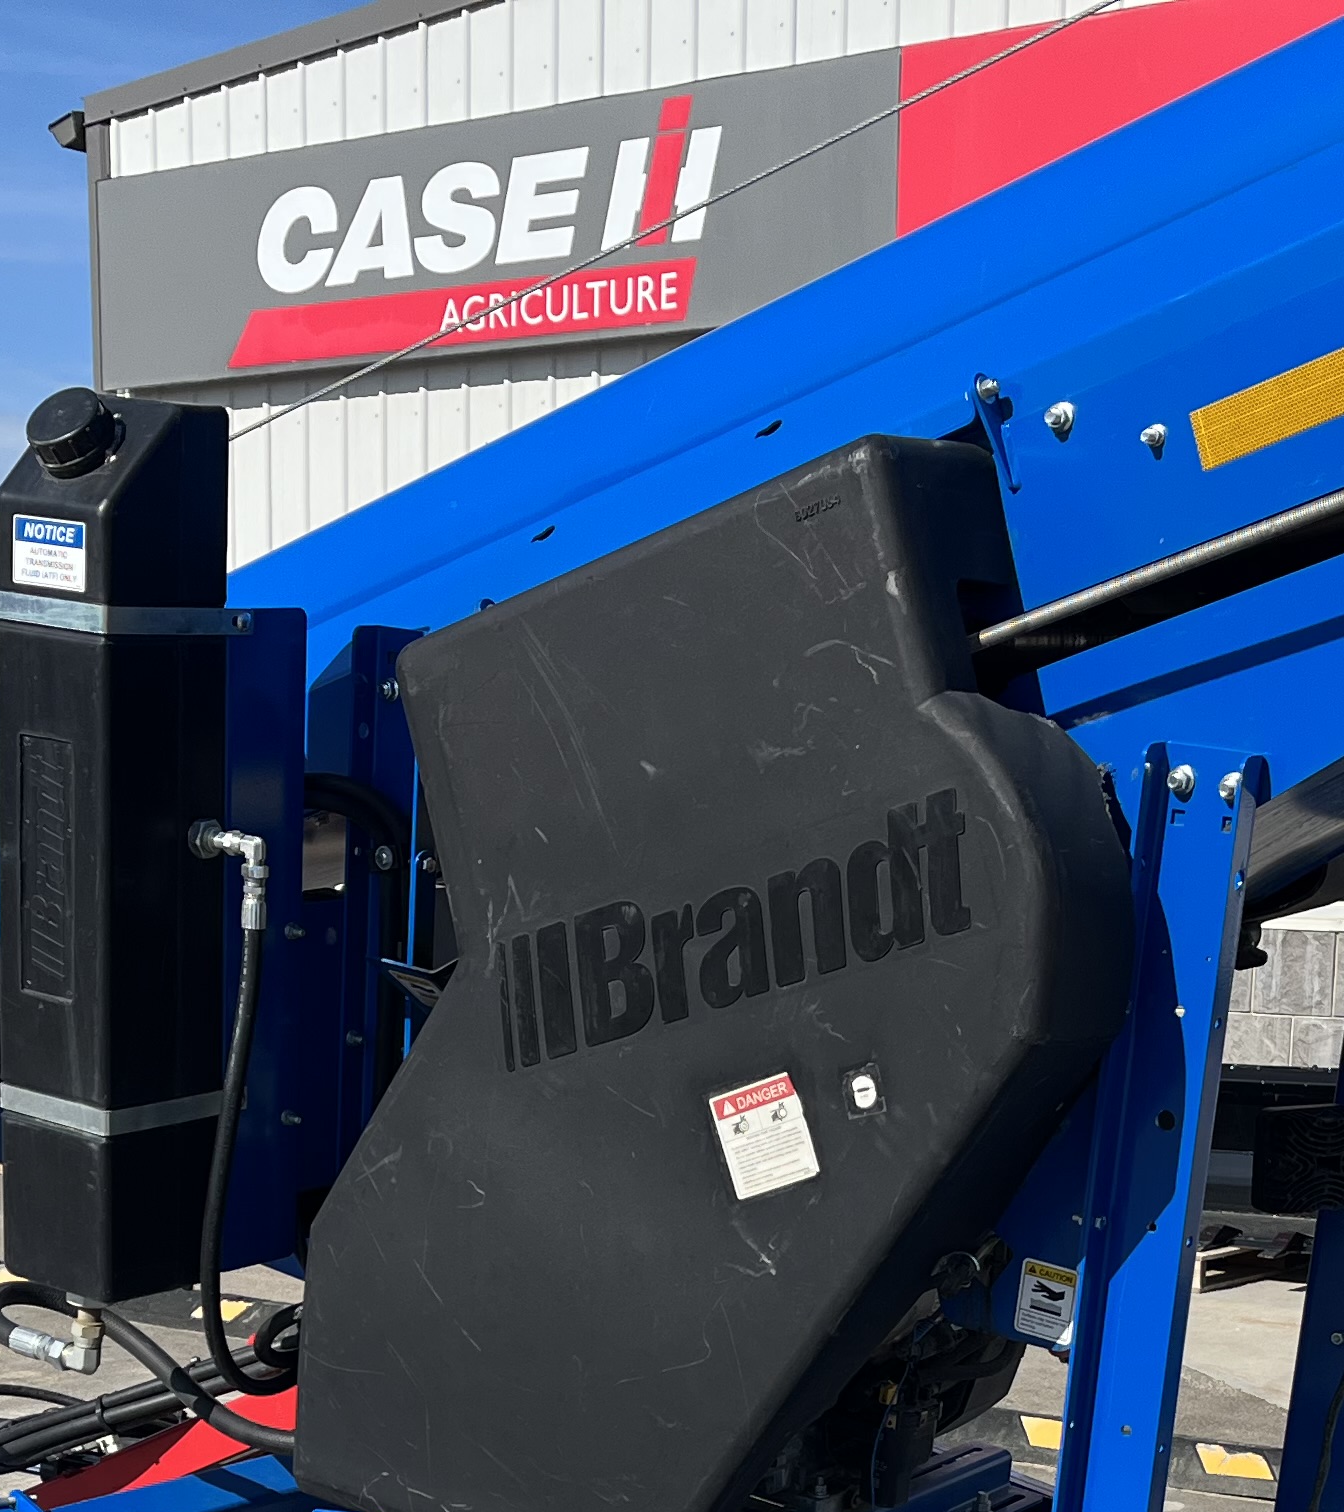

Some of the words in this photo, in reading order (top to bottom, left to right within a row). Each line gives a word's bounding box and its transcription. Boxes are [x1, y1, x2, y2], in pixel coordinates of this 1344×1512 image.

[256, 146, 590, 294] CASE
[438, 272, 680, 336] AGRICULTURE
[23, 521, 75, 543] NOTICE
[25, 557, 74, 571] TRANSMISSION
[29, 547, 68, 559] AUTOMATIC
[21, 568, 40, 578] FLUID
[59, 574, 77, 583] ONLY
[573, 788, 973, 1049] Brandt
[736, 1081, 788, 1110] DANGER
[1038, 1268, 1074, 1284] CAUTION
